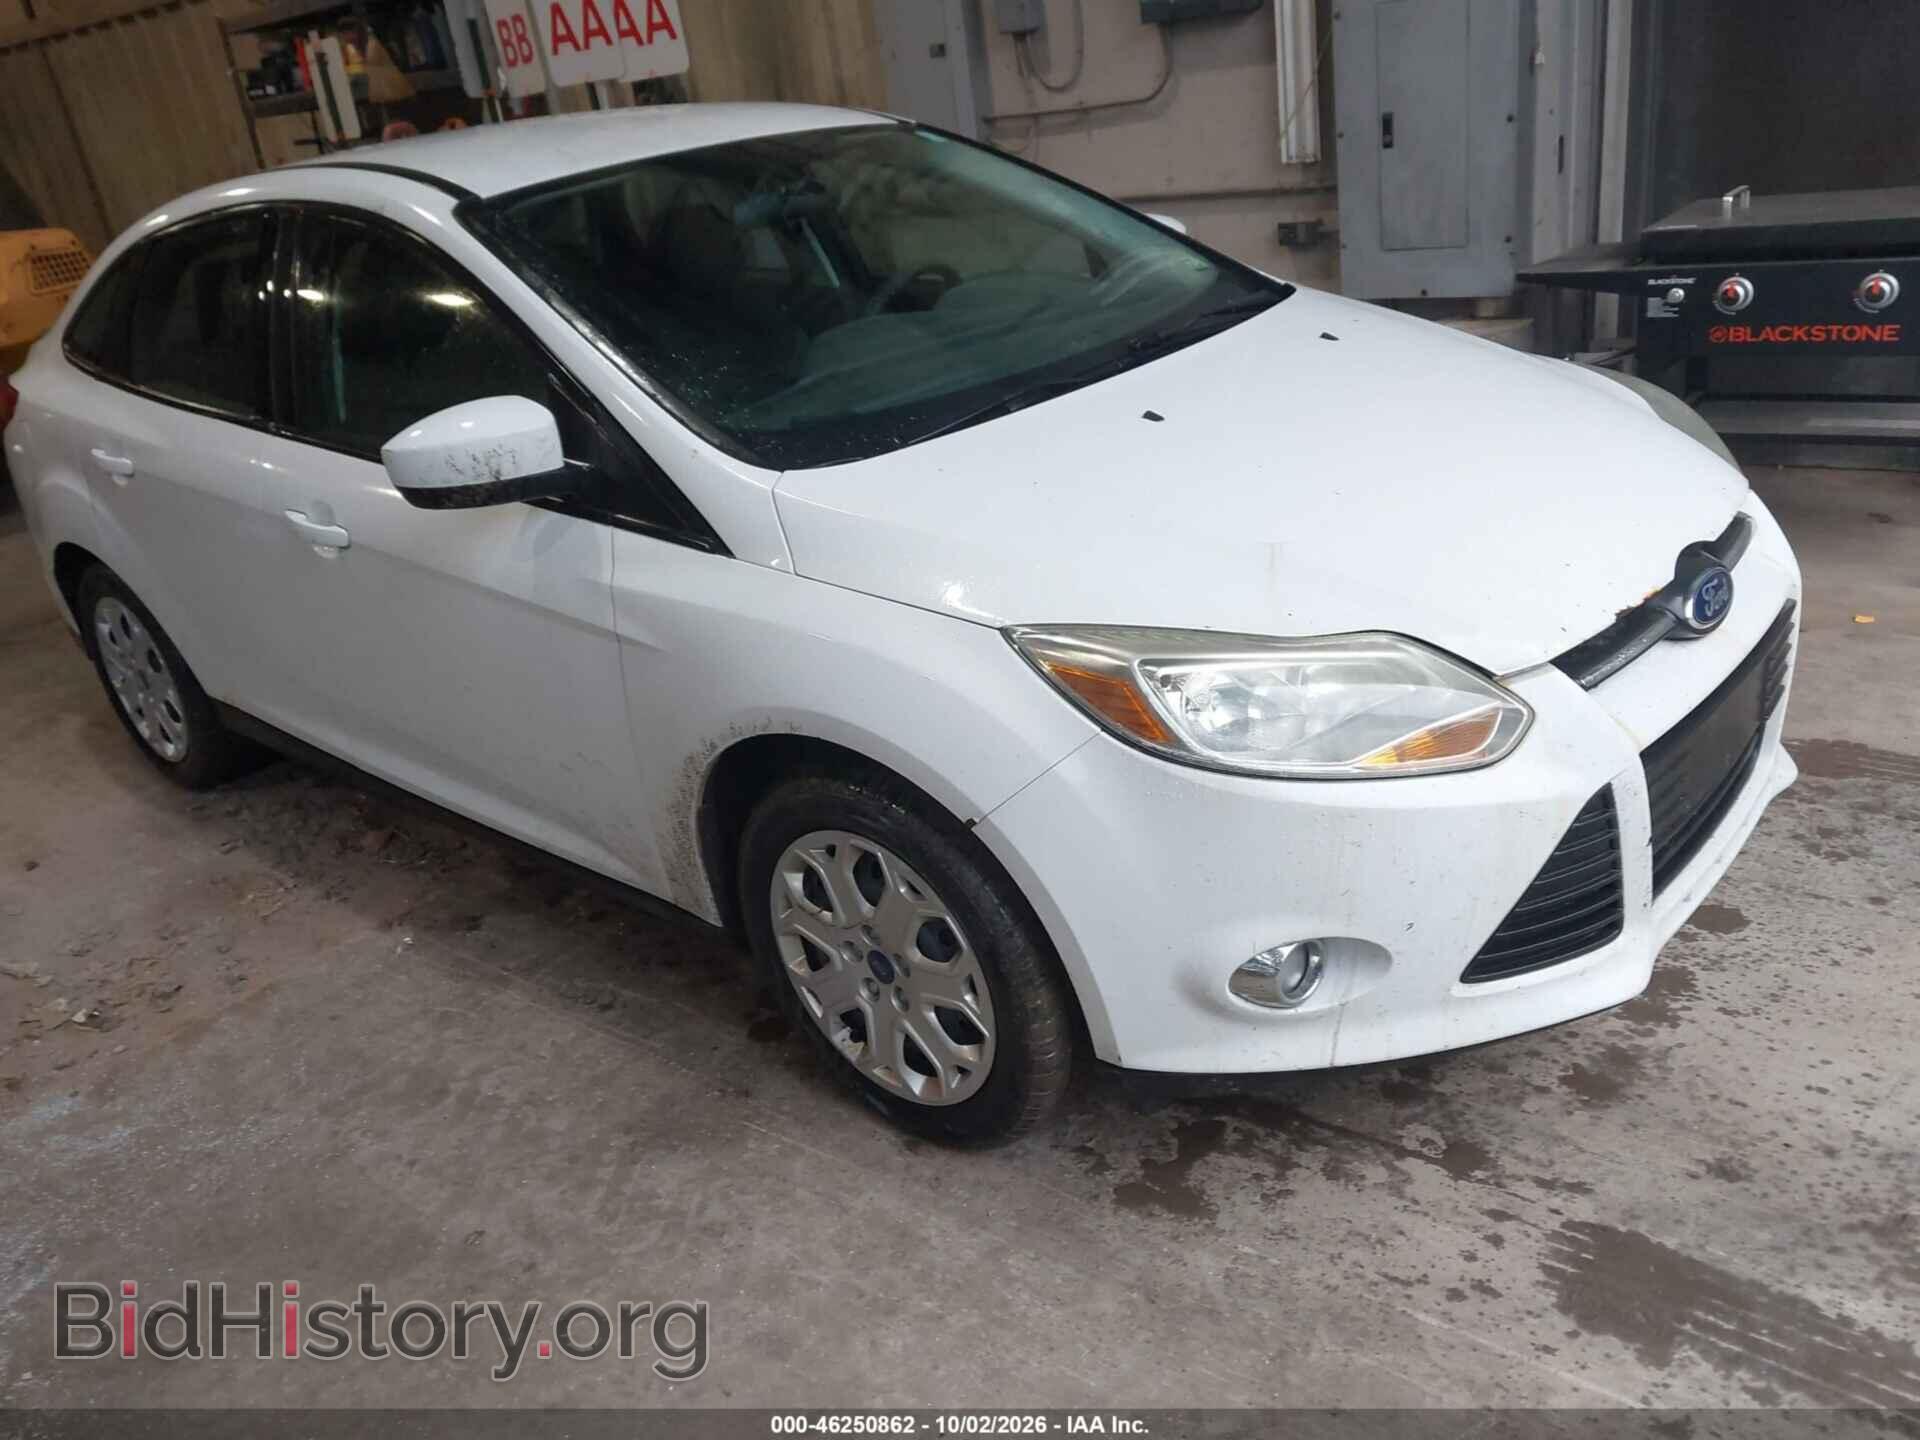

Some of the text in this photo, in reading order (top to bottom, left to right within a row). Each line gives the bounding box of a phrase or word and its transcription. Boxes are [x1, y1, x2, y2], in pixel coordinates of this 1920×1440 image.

[496, 14, 533, 68] BB
[1647, 277, 1697, 286] BLACKSTONE
[1728, 324, 1901, 343] BLACKSTONE
